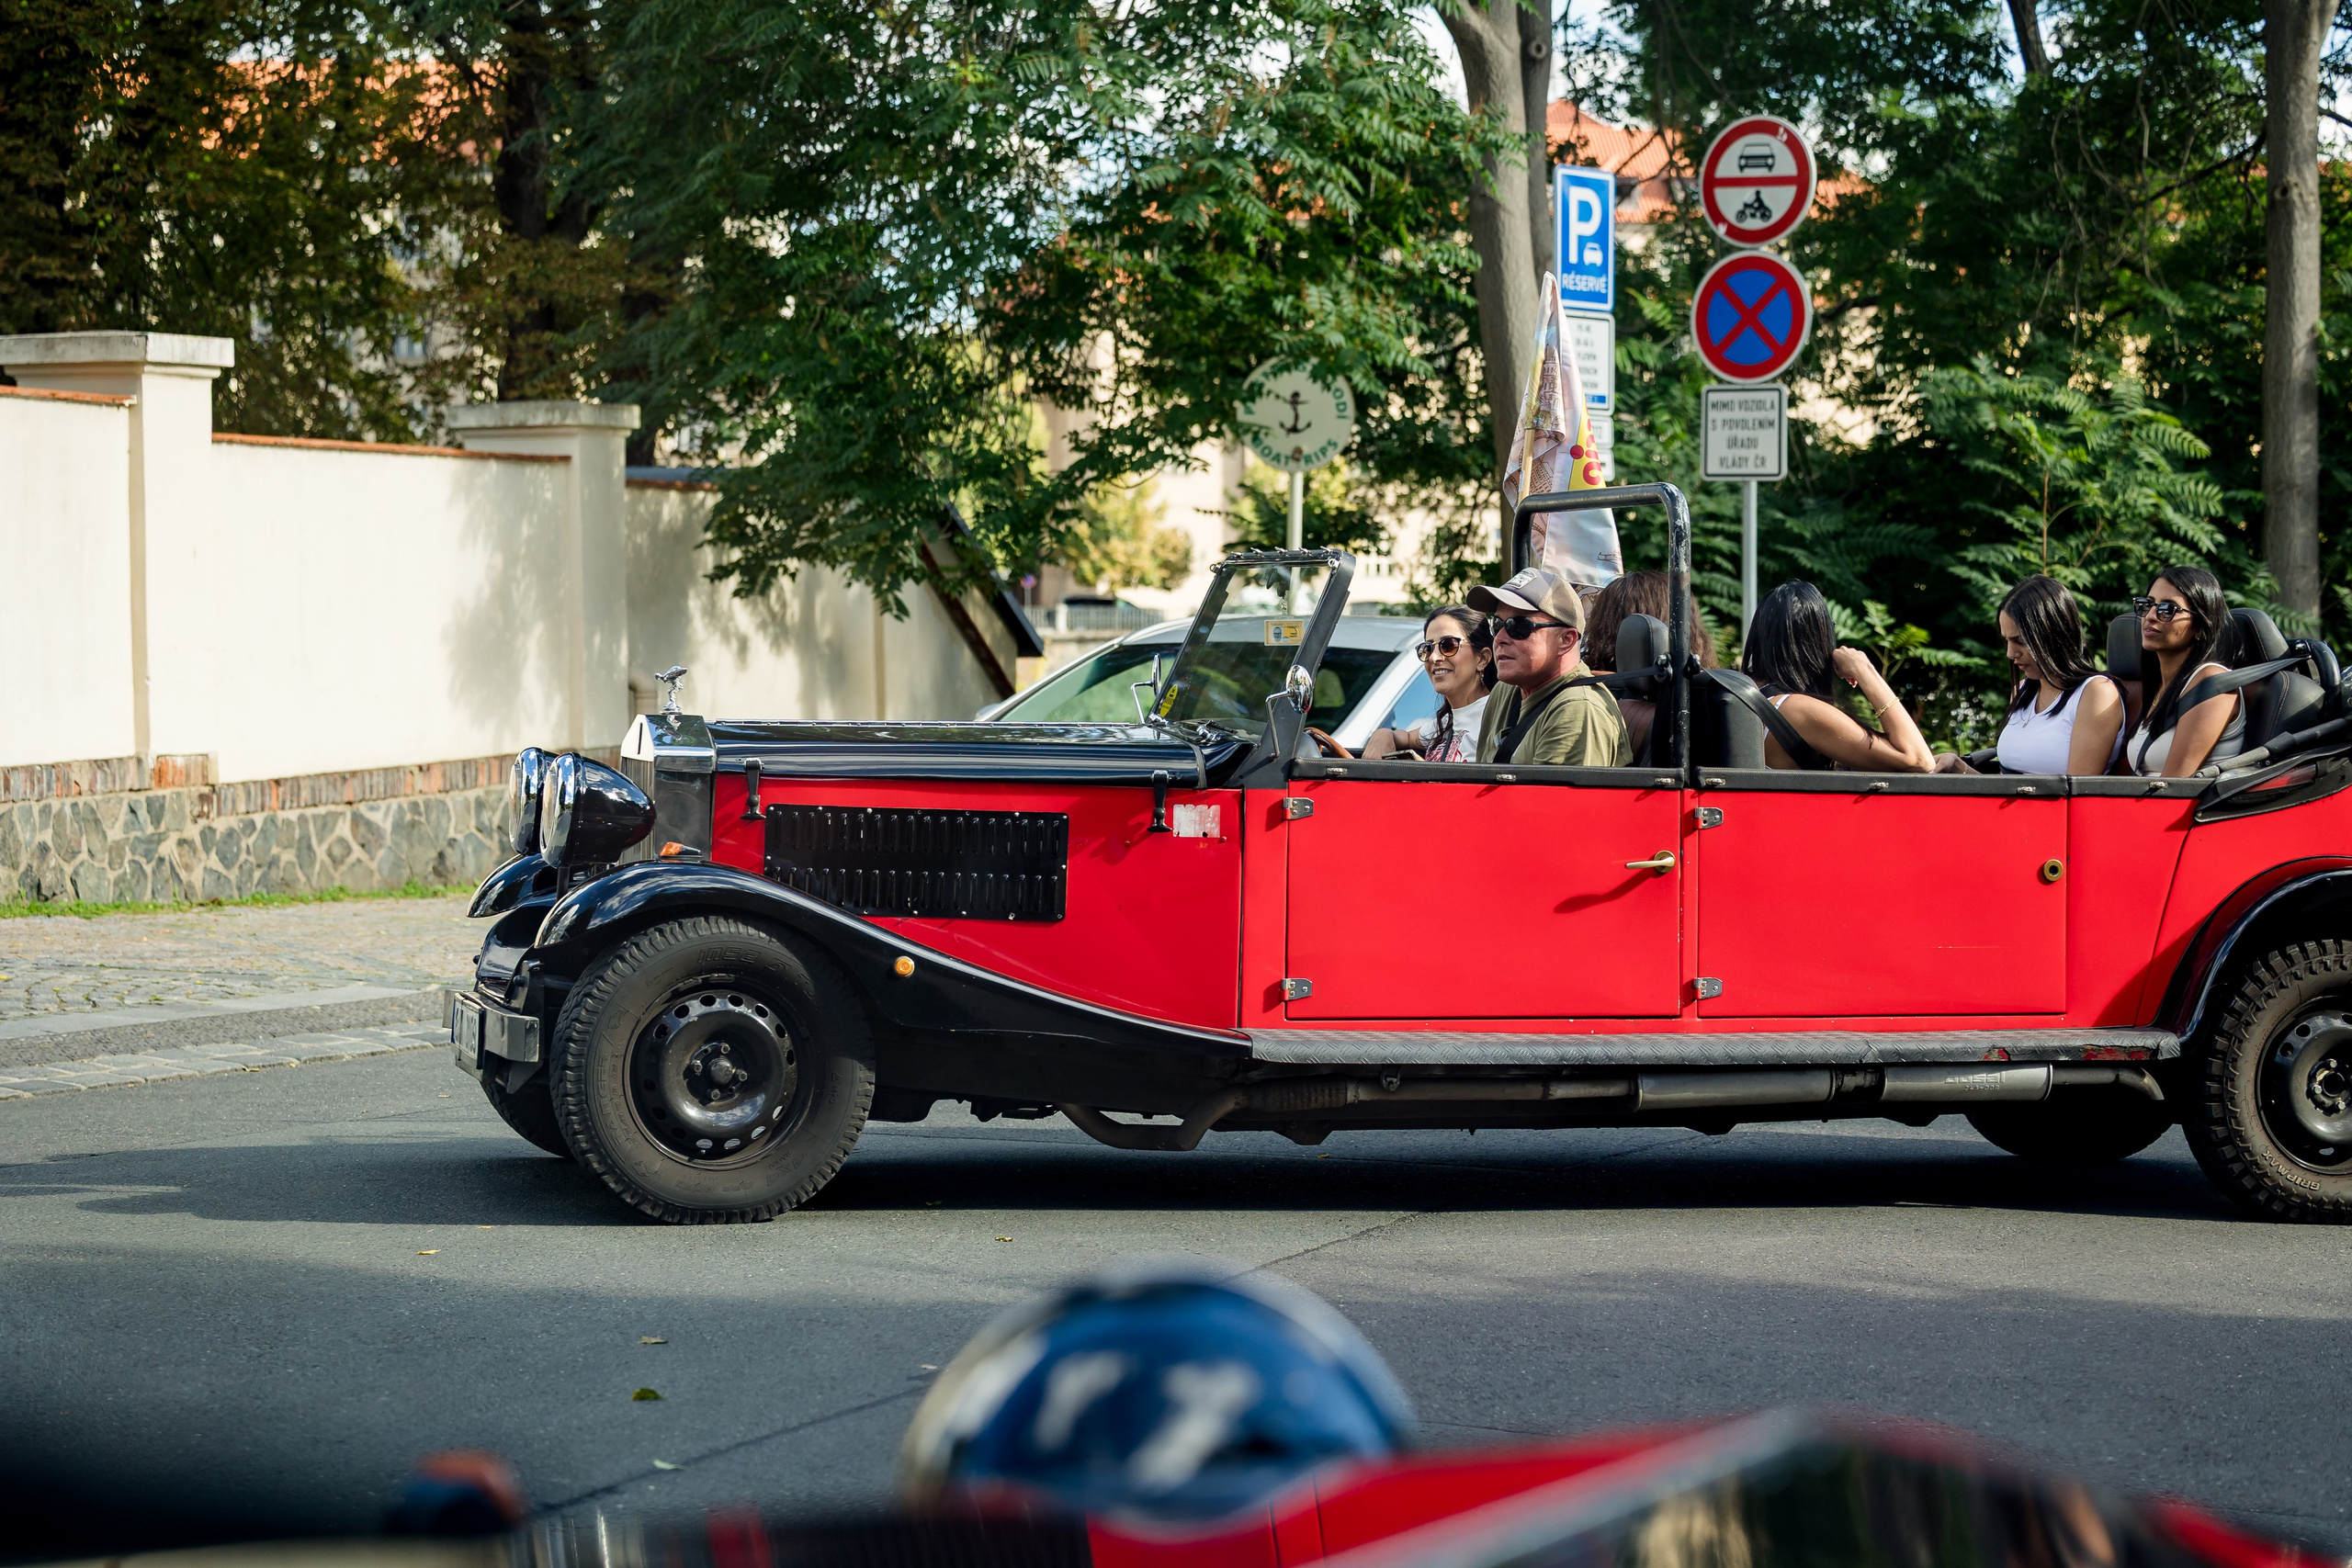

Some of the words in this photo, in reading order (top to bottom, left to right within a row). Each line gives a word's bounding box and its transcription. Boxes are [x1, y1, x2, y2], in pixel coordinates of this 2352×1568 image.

[1568, 186, 1602, 265] P
[1562, 271, 1608, 294] RÉSERVÉ
[1710, 400, 1736, 412] MIMO
[1738, 400, 1775, 412] VOZIDLA
[1711, 419, 1717, 431] S
[1722, 417, 1775, 431] POVOLENÍM
[1297, 438, 1339, 467] RIPS
[2261, 1149, 2321, 1191] GRIPMAX
